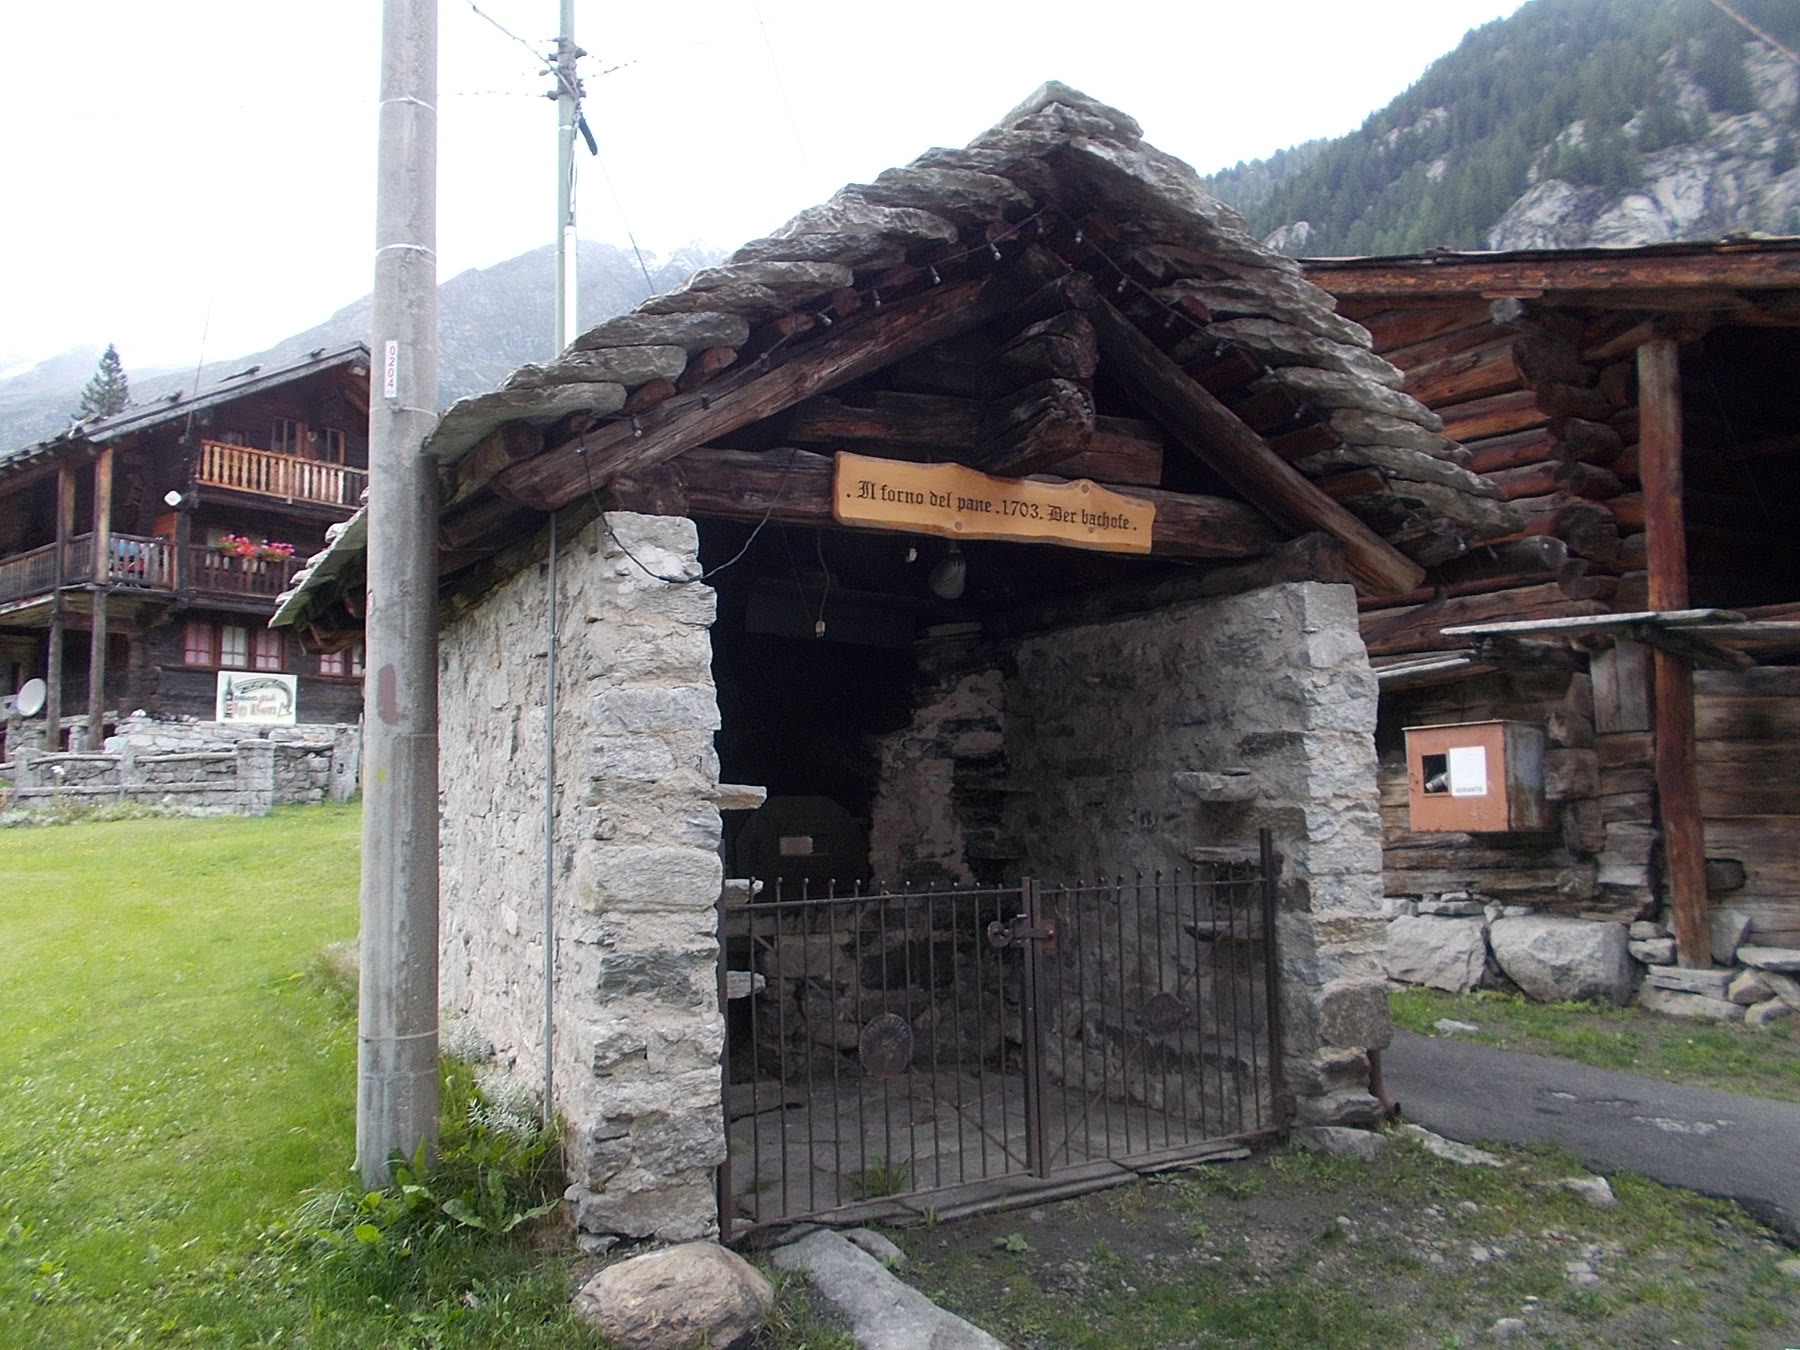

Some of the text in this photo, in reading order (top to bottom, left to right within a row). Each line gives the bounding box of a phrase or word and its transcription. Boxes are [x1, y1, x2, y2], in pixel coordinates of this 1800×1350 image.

[387, 344, 397, 389] 0204
[857, 480, 876, 500] Il
[880, 484, 924, 505] forno
[929, 490, 952, 509] del
[957, 497, 993, 513] pane
[1047, 504, 1077, 523] Der
